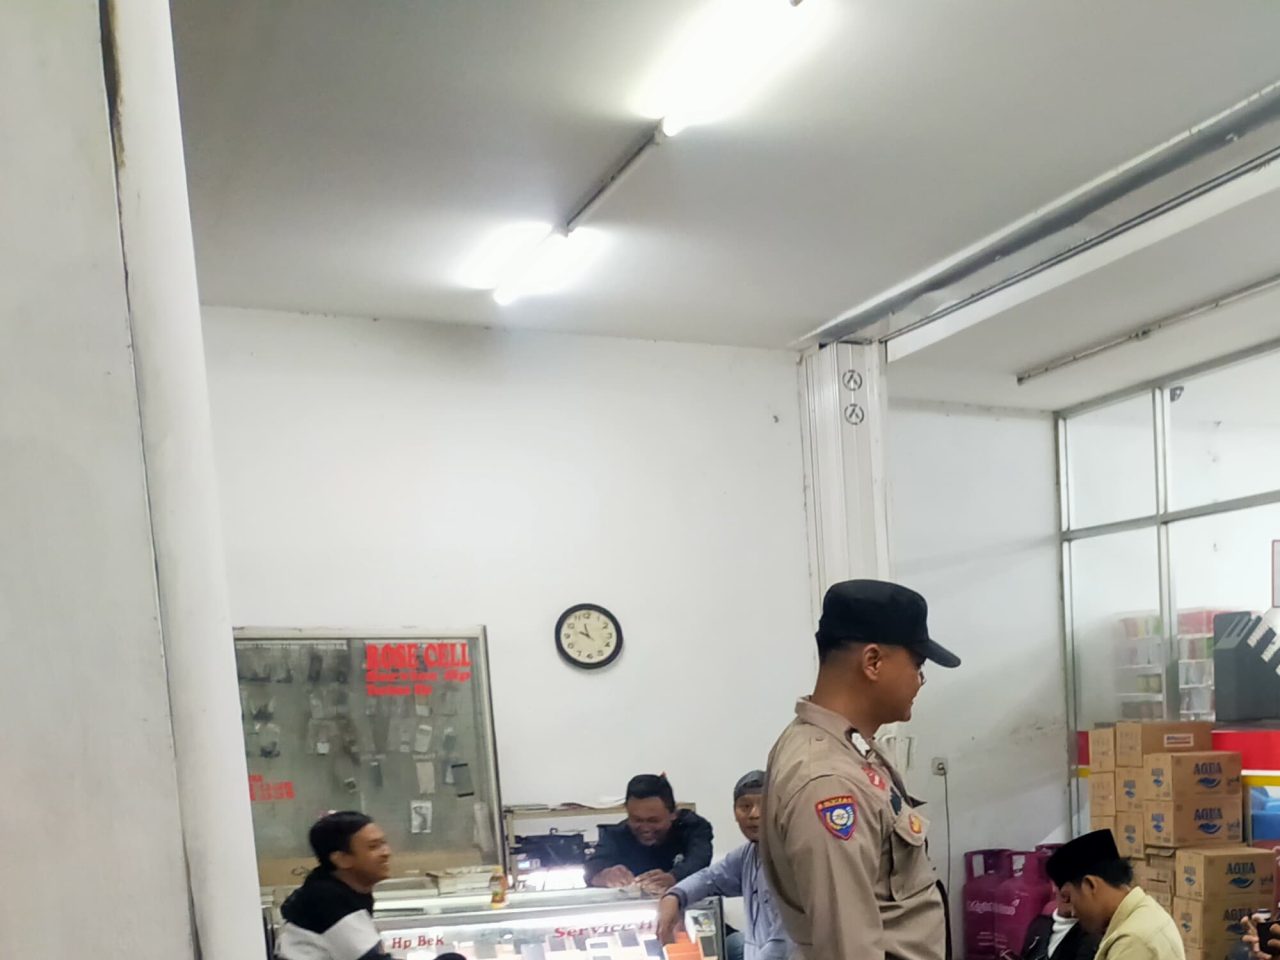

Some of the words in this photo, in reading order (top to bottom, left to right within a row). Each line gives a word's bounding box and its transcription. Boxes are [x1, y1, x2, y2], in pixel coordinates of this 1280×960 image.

[1193, 761, 1223, 776] AQUA
[1193, 807, 1224, 822] AQUA
[1225, 861, 1256, 876] AQUA
[391, 937, 412, 950] Hp
